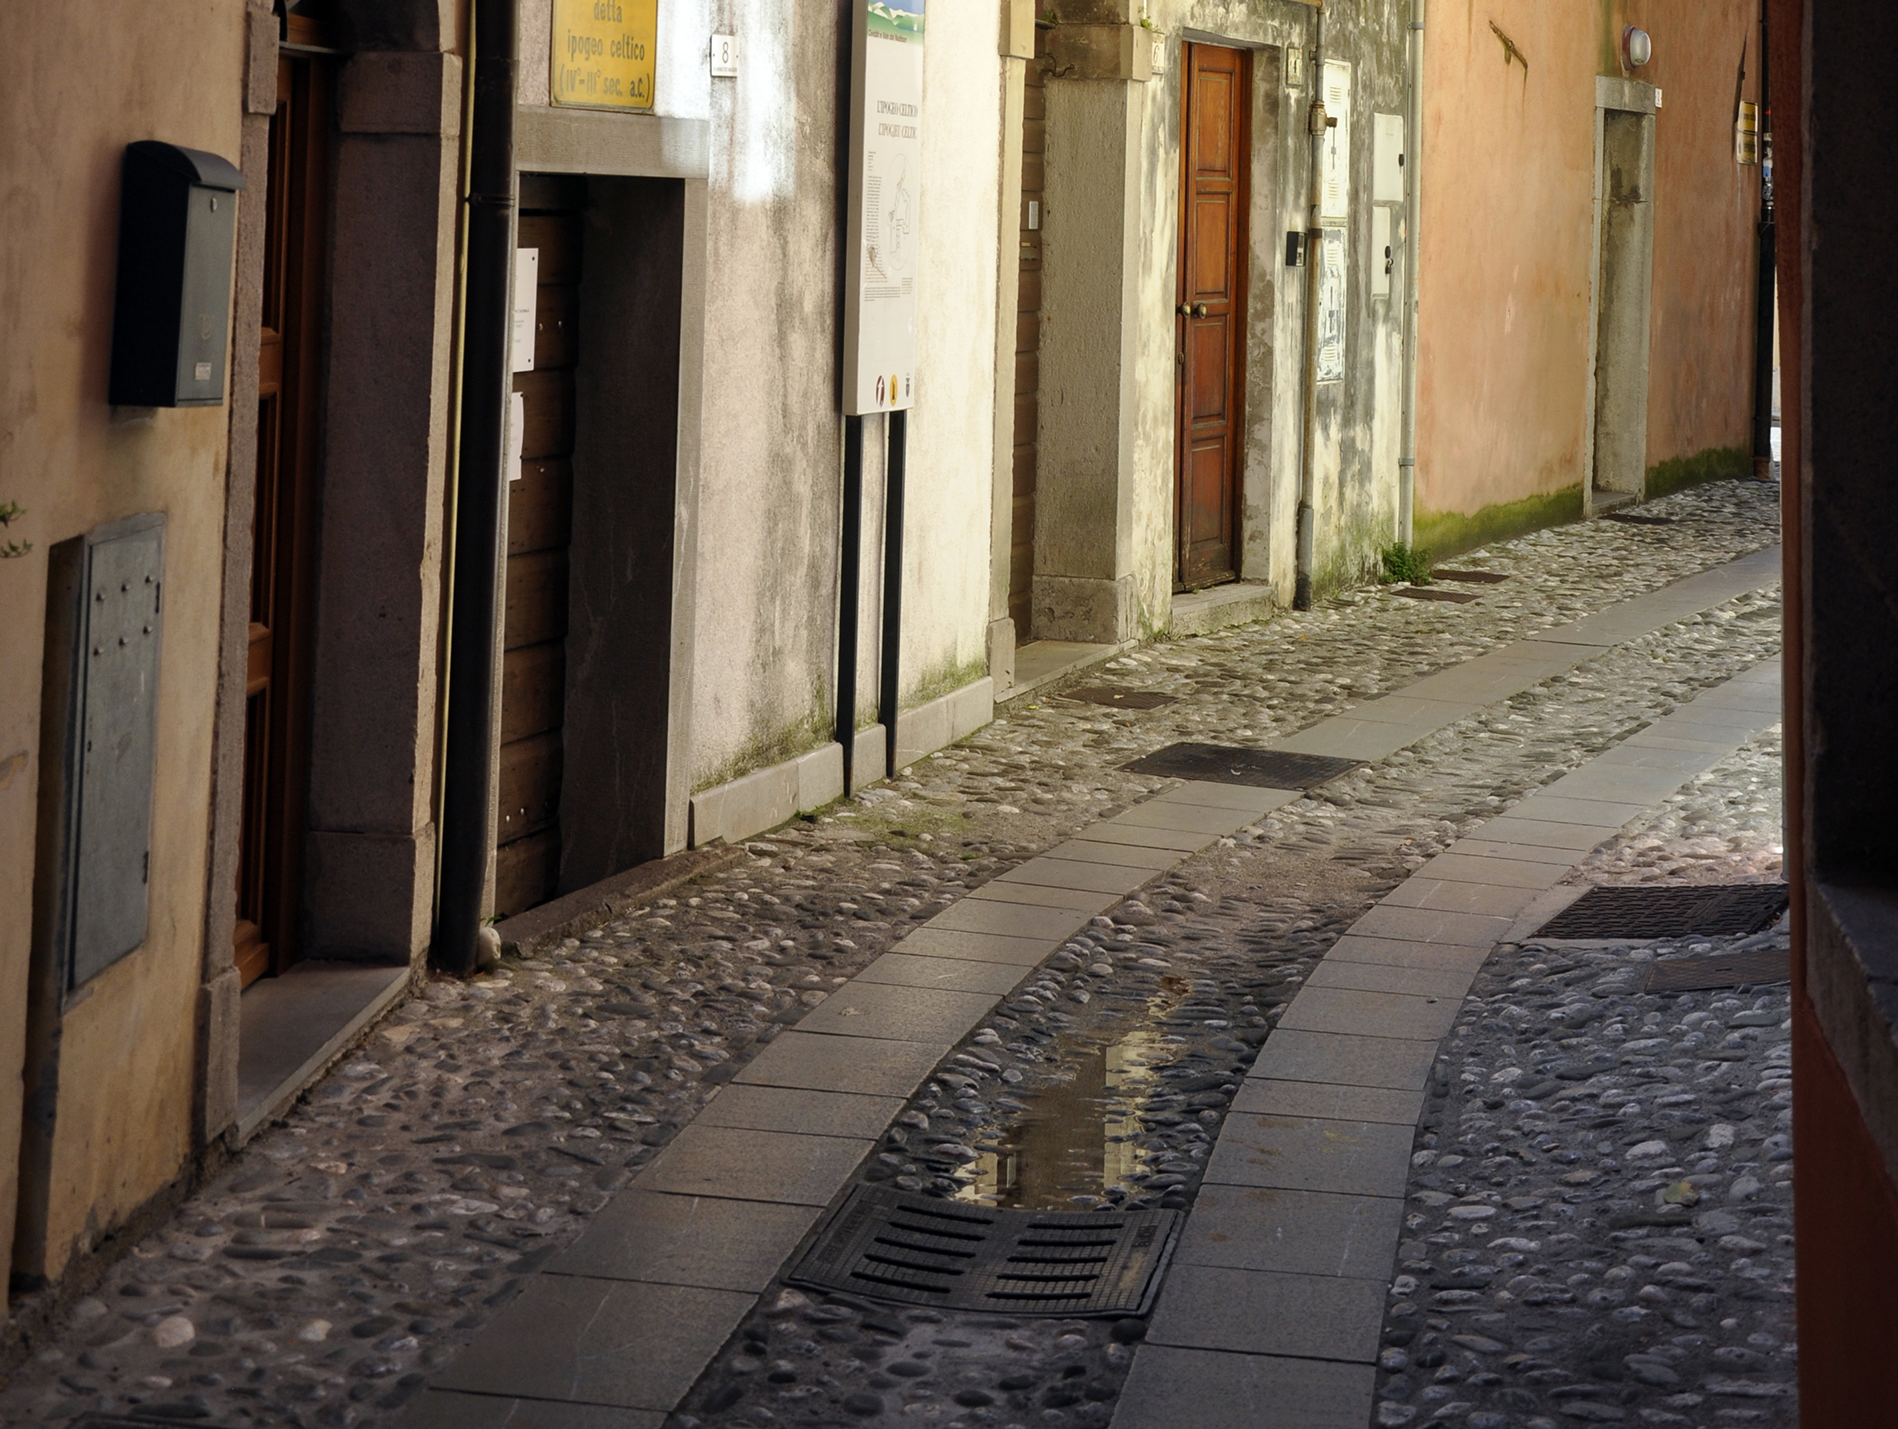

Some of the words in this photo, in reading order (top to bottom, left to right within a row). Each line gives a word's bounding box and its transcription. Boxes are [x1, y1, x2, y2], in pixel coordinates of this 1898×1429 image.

[567, 28, 603, 62] ipogeo
[610, 33, 645, 61] celtico
[722, 41, 729, 64] 8
[603, 76, 623, 96] sec.
